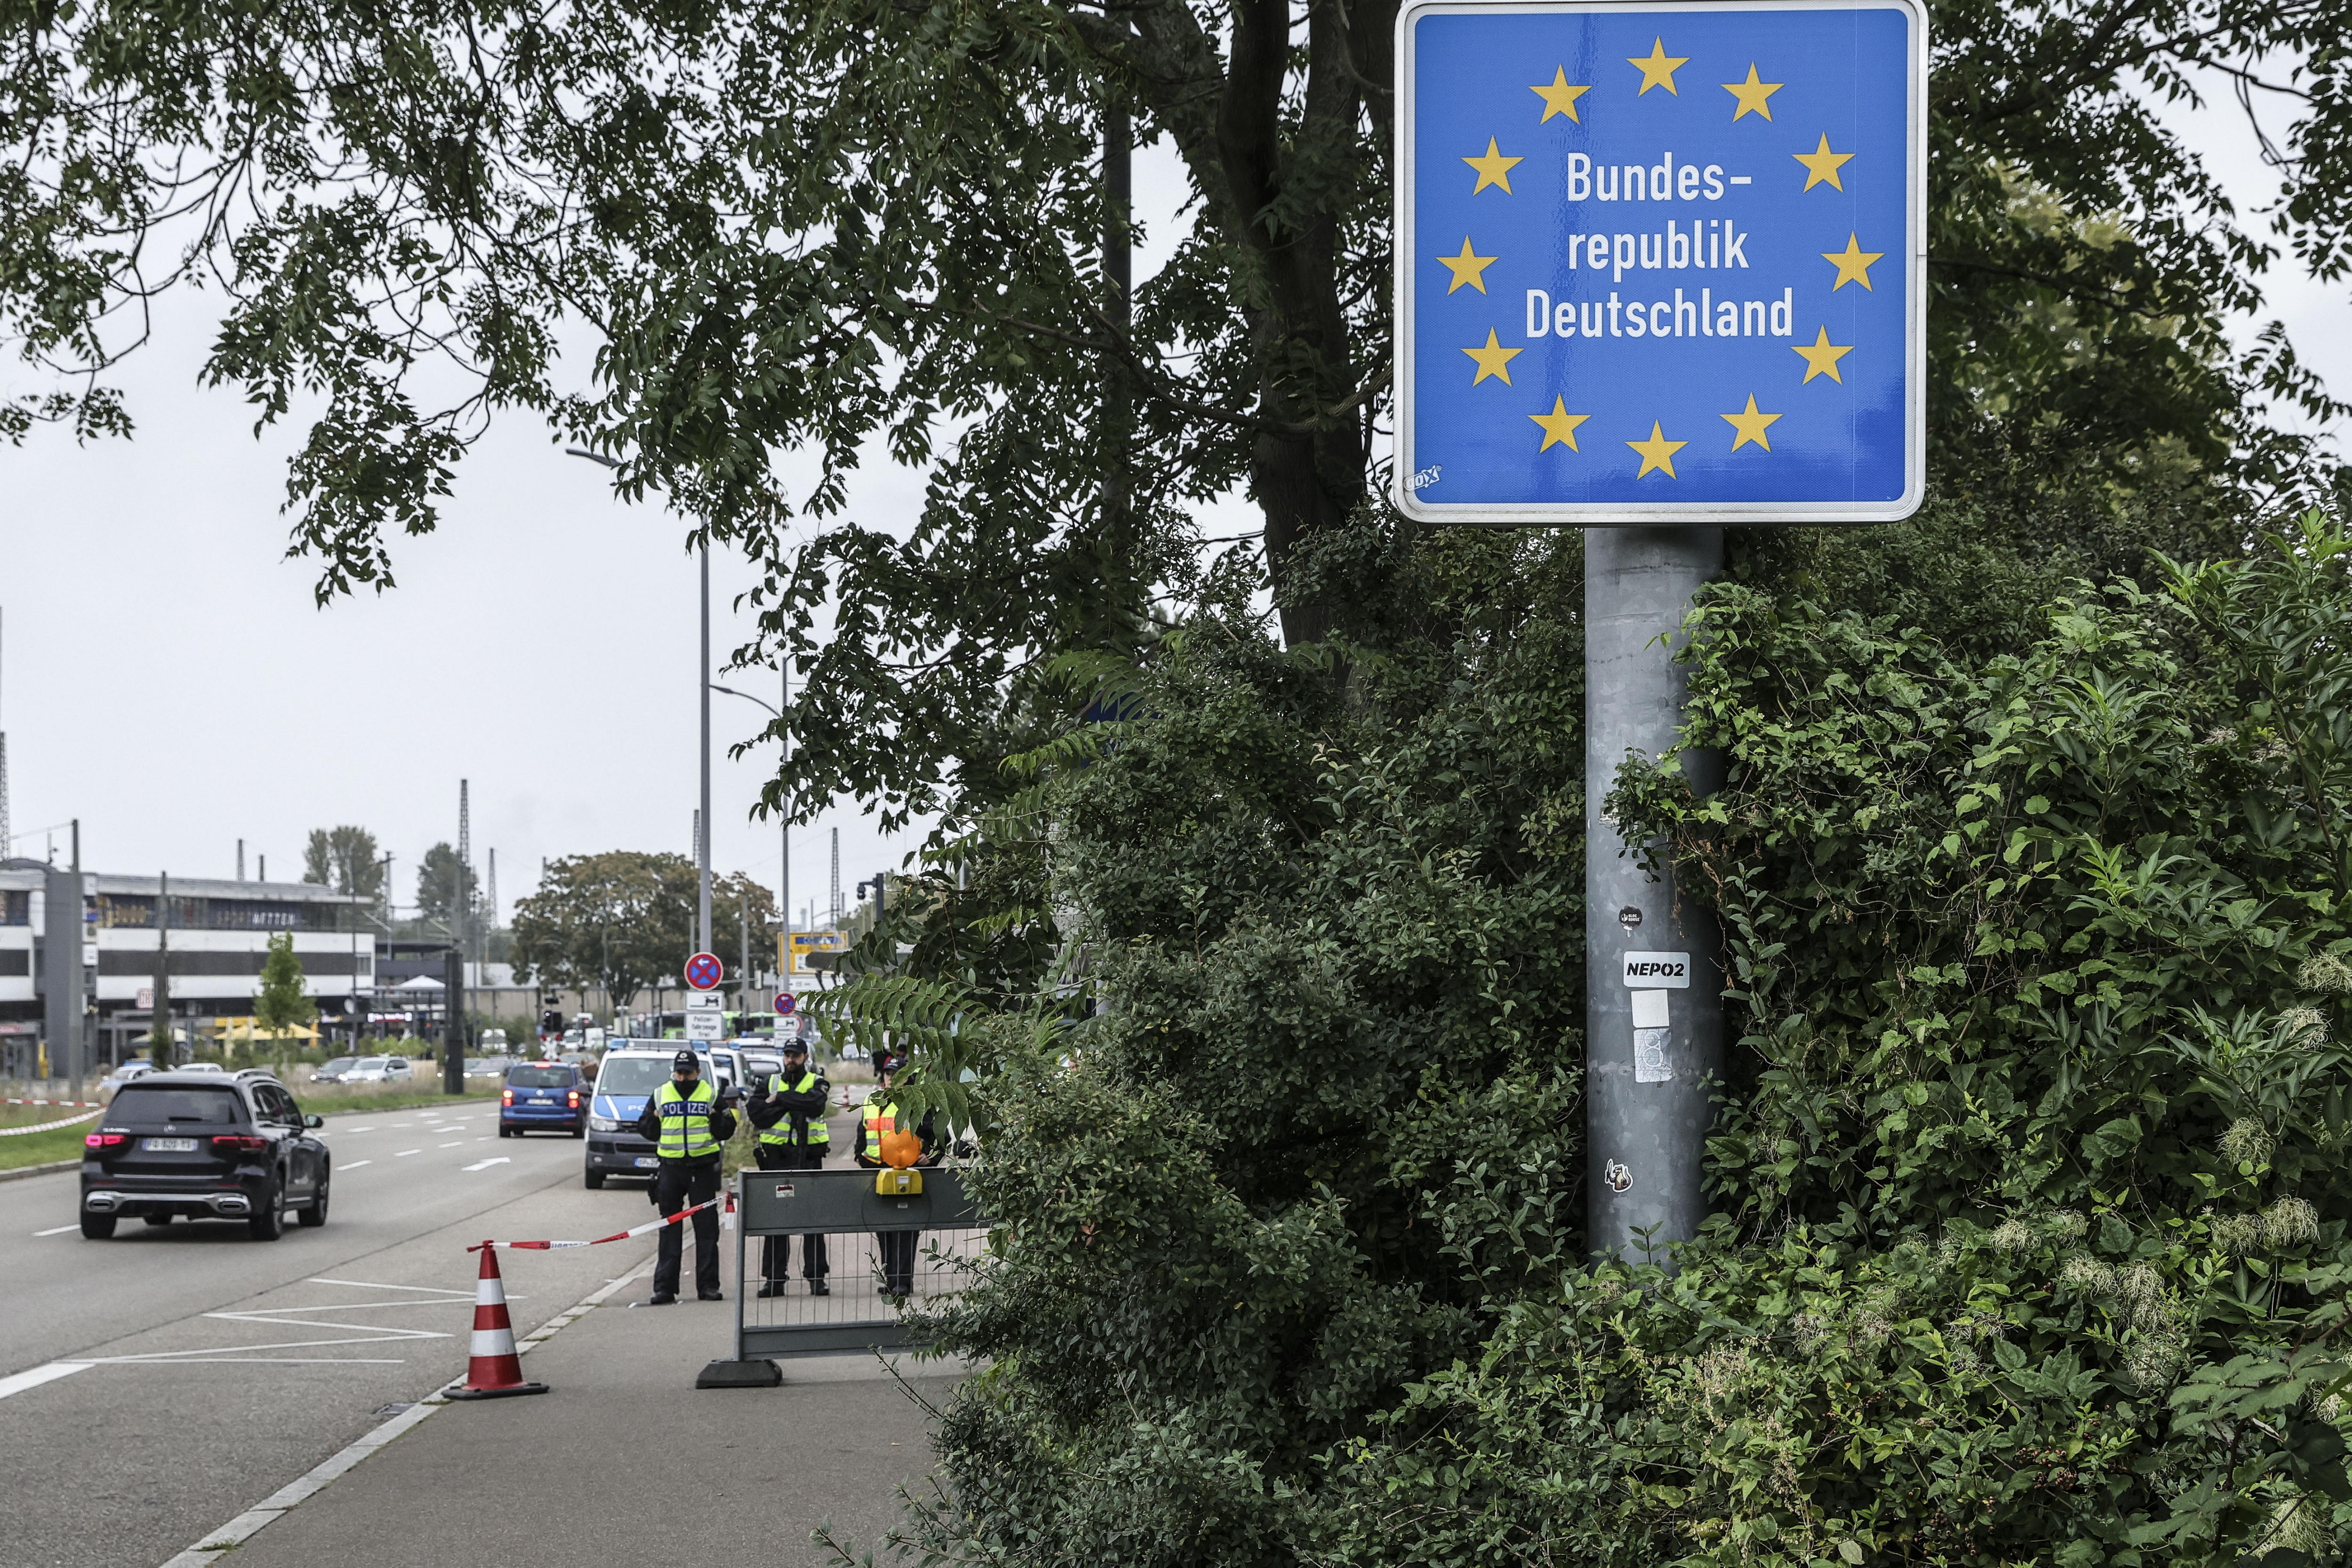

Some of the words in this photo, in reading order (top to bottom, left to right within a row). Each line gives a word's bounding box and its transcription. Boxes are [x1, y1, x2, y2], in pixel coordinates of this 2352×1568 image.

[1567, 151, 1753, 201] Bundes-
[1568, 219, 1749, 283] republik
[1526, 287, 1793, 338] Deutschland
[1627, 963, 1685, 977] NEPO2
